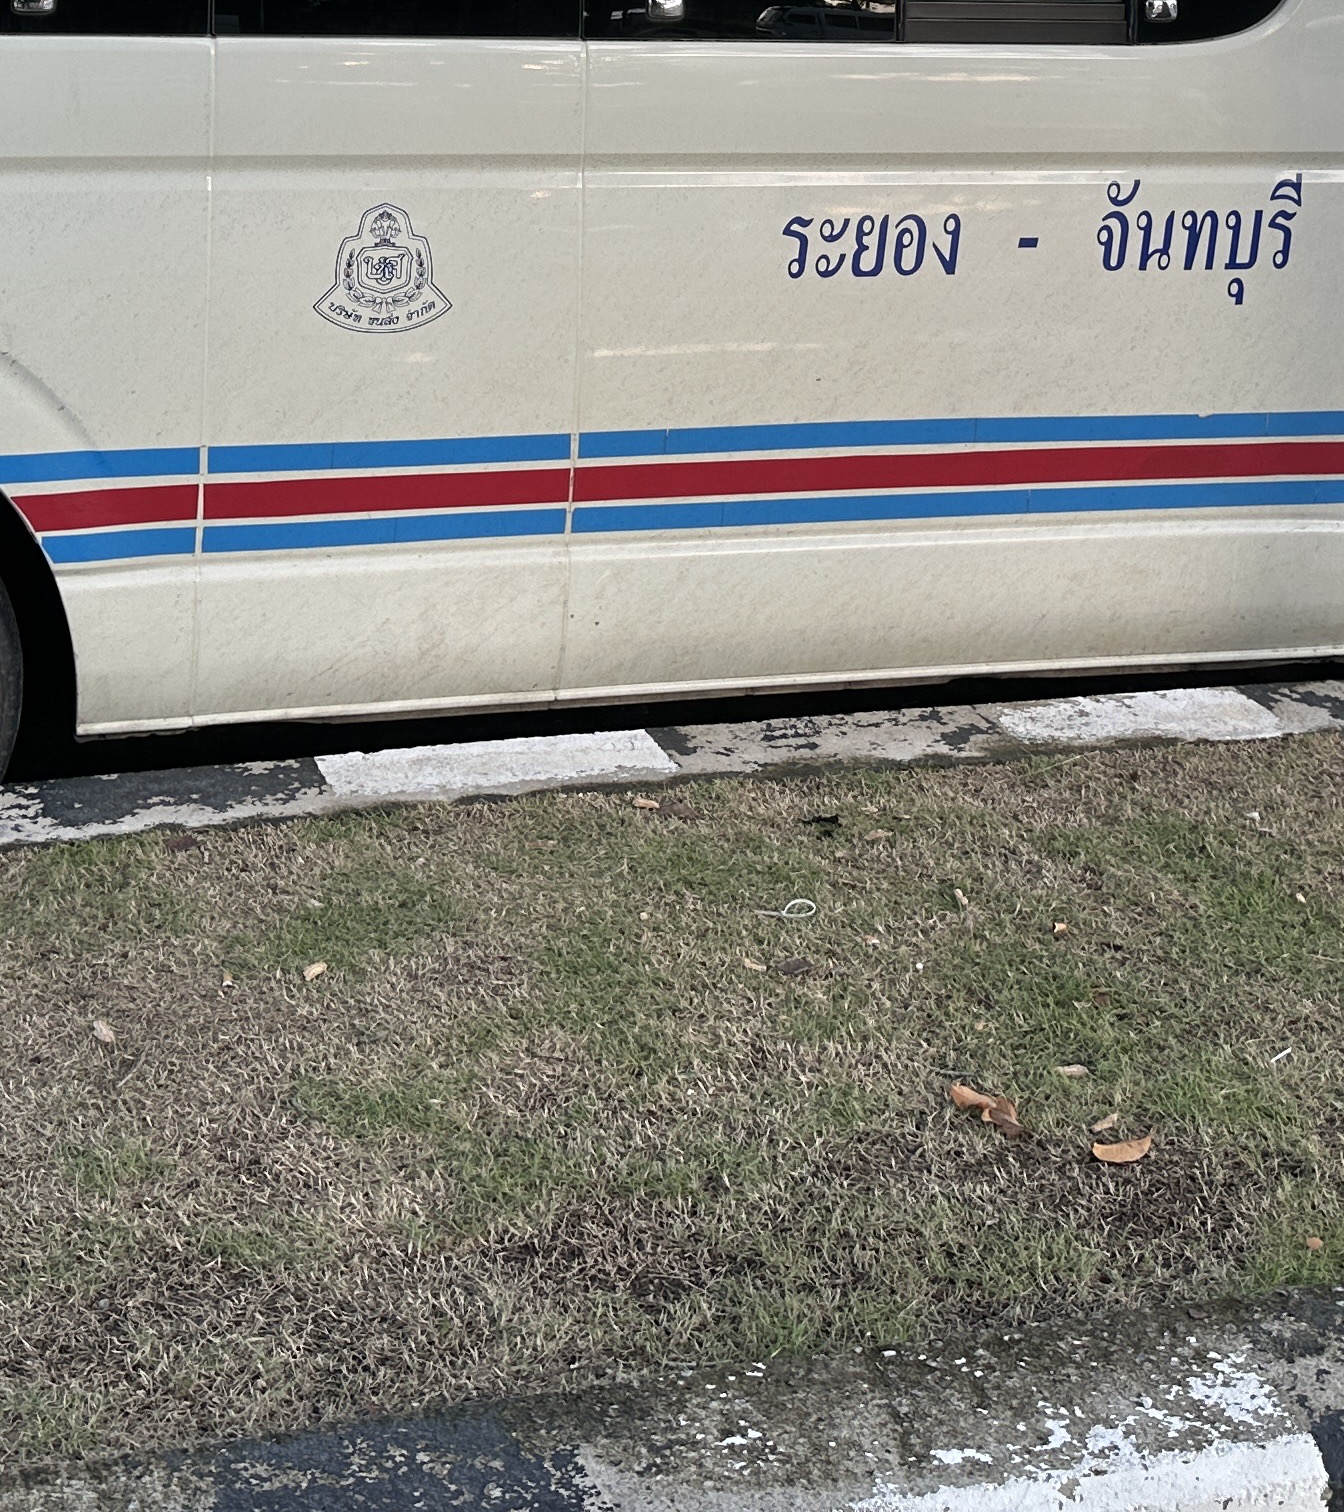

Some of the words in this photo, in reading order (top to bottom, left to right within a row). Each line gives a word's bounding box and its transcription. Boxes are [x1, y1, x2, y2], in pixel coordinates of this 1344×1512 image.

[782, 213, 962, 280] ระยอง
[1096, 173, 1303, 306] จันทบุรี
